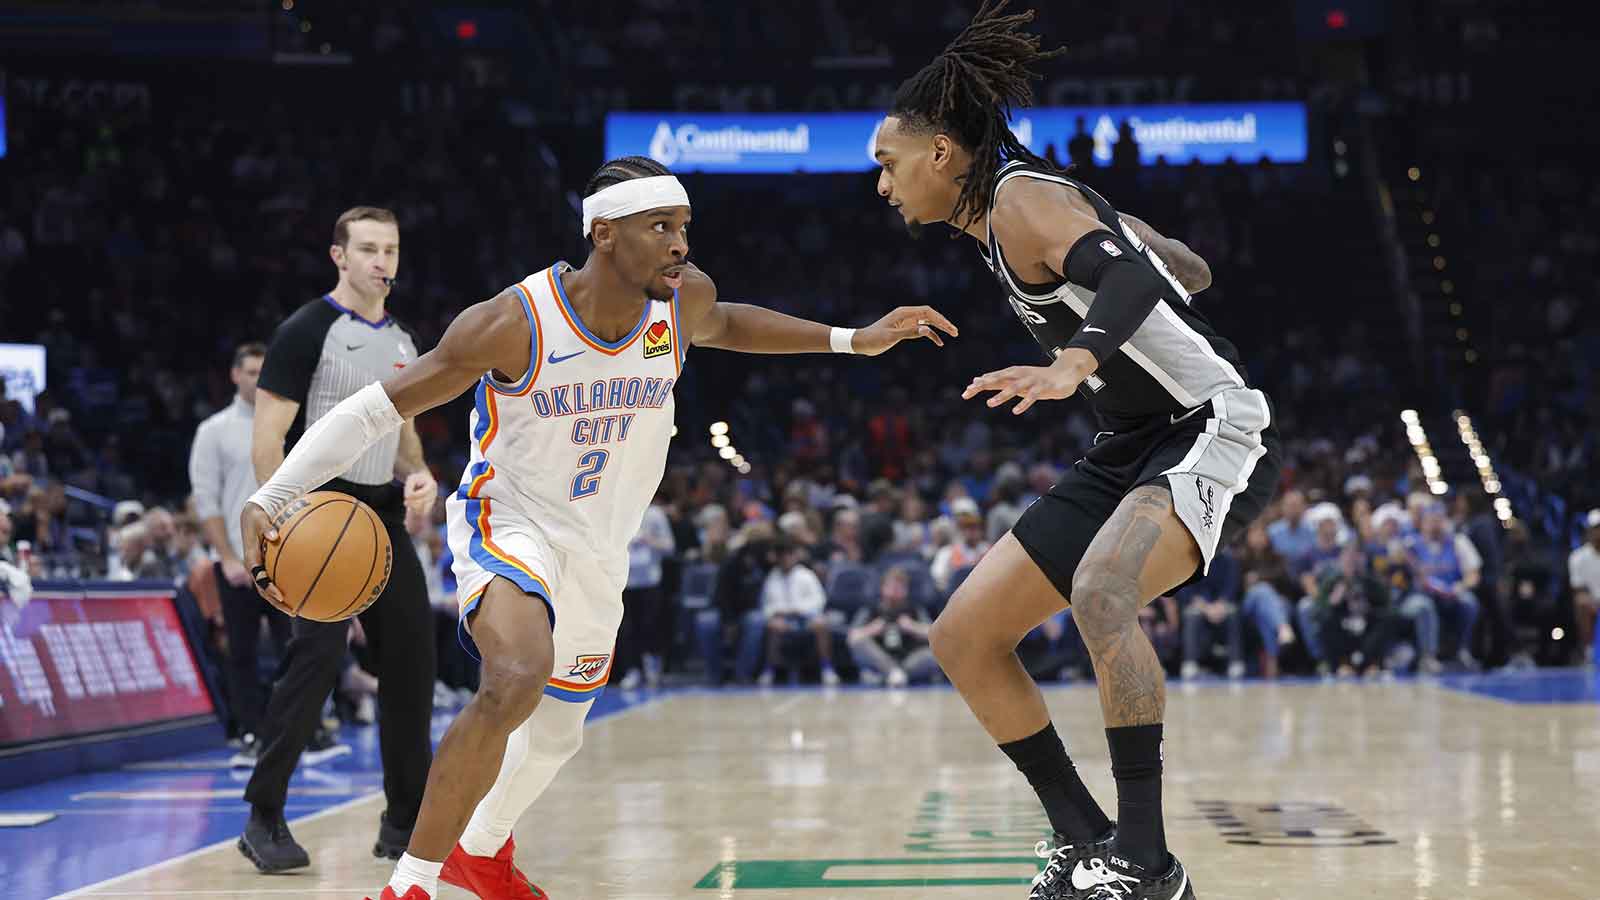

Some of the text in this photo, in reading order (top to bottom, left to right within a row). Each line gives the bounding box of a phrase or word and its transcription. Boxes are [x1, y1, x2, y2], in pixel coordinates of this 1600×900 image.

[675, 123, 809, 152] Continental
[531, 377, 673, 418] OKLAHOMA
[571, 414, 635, 445] CITY
[569, 449, 609, 502] 2
